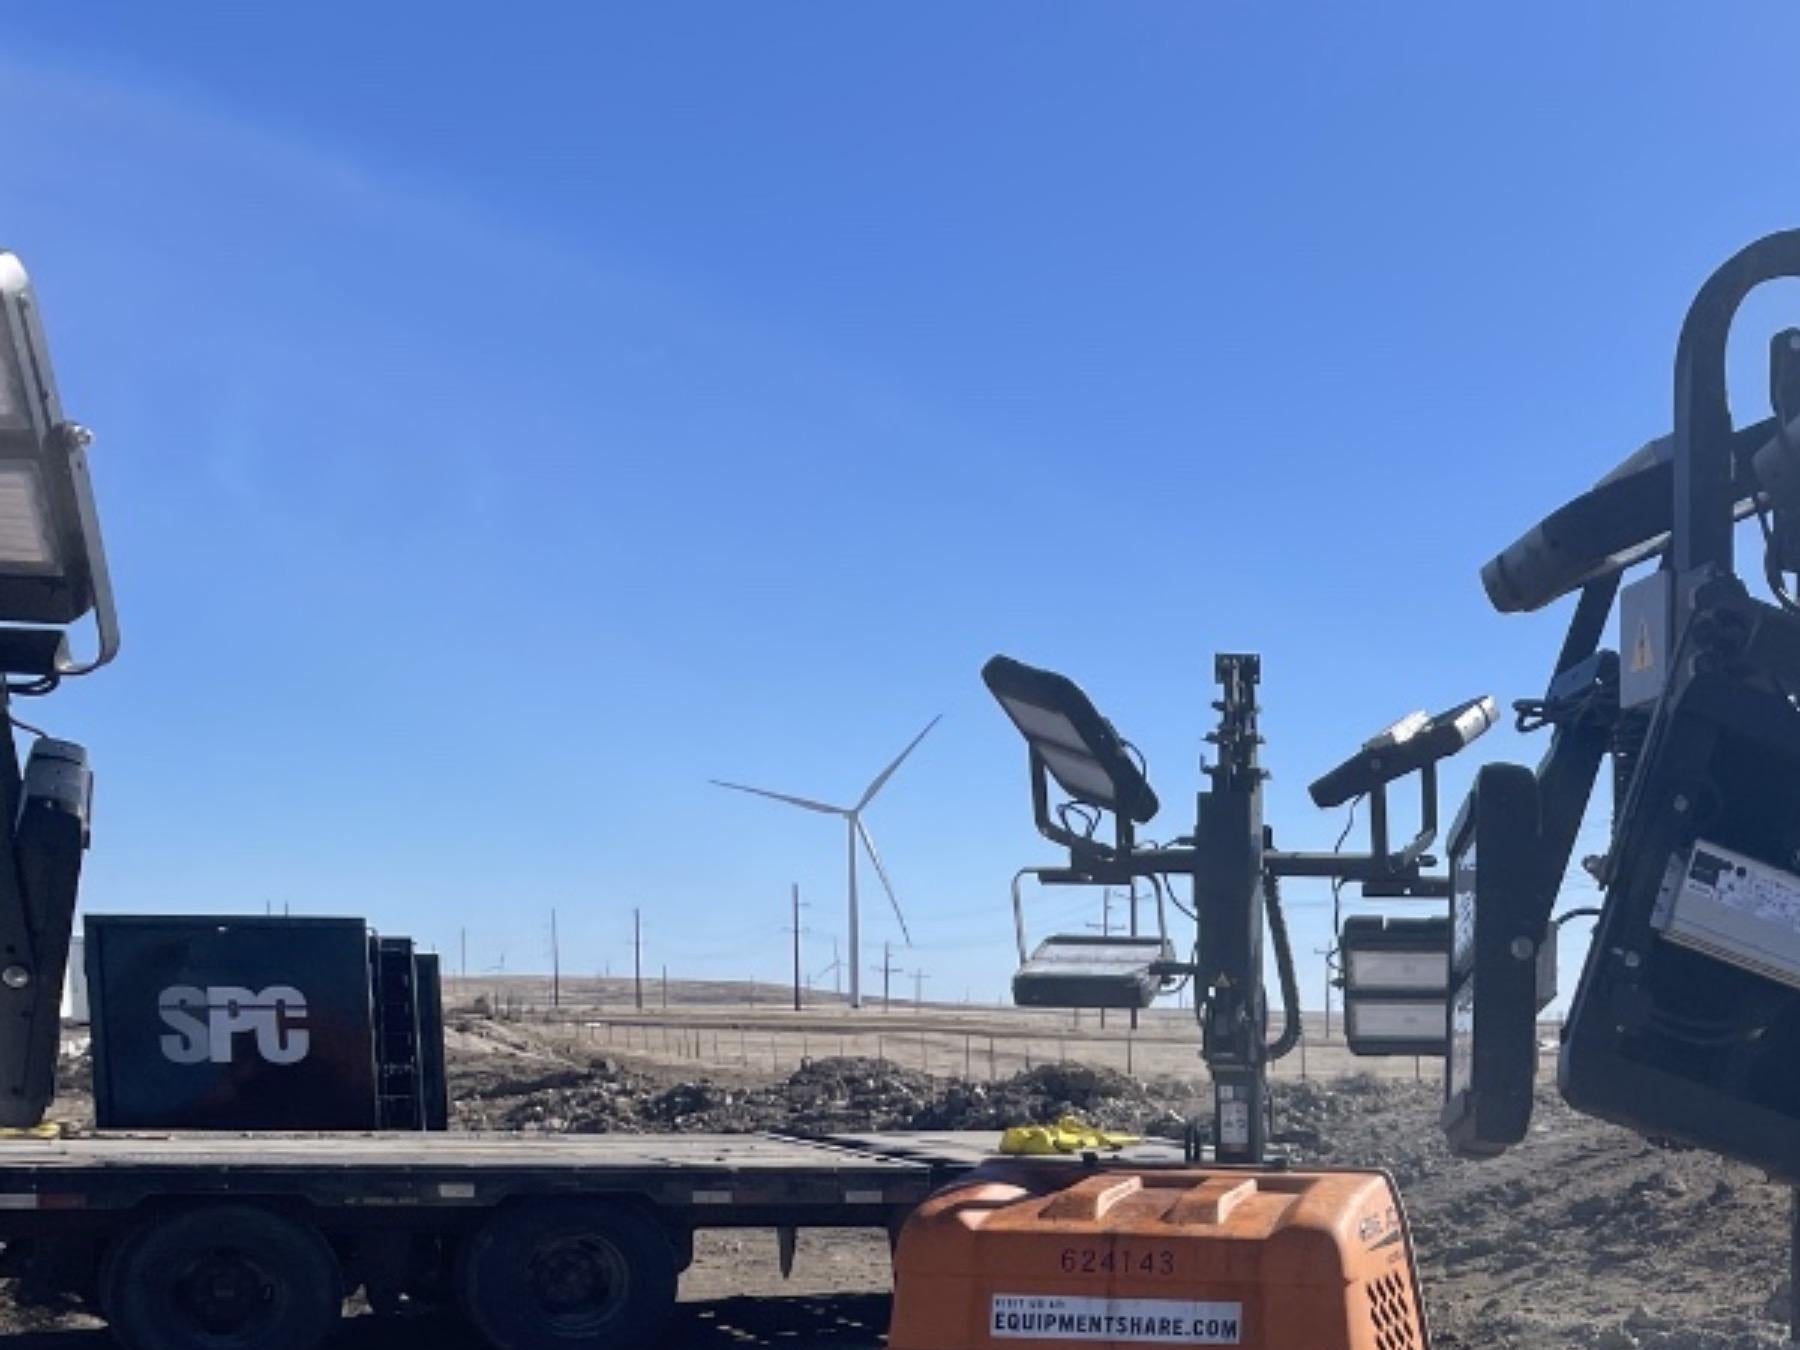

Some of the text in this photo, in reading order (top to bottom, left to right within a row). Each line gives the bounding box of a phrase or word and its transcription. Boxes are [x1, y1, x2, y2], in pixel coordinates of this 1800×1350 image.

[158, 986, 310, 1064] SPC
[1061, 1249, 1175, 1275] 624143
[995, 1312, 1238, 1339] EQUIPMENTSHARE.COM
